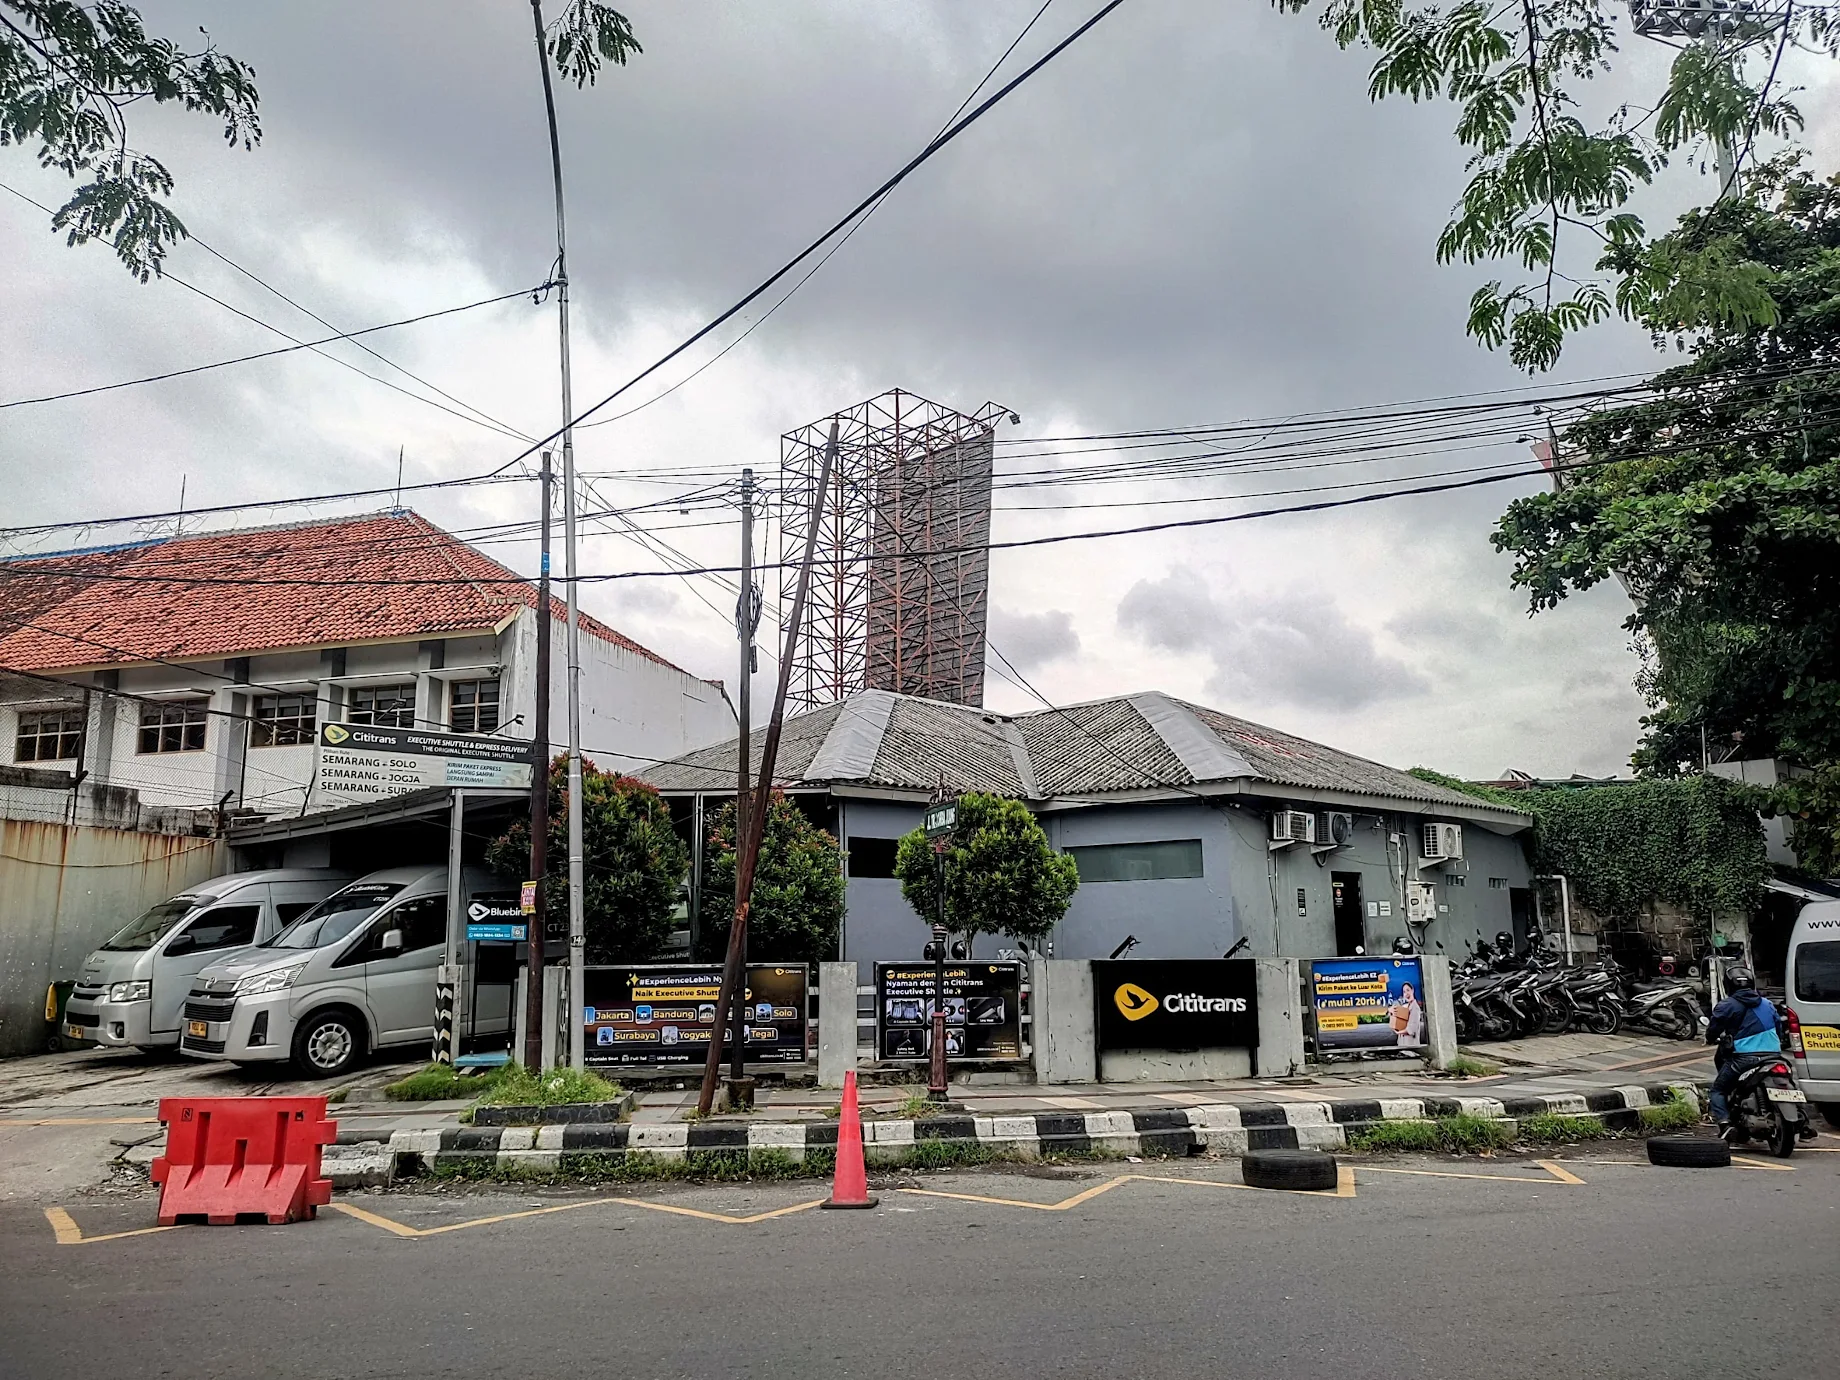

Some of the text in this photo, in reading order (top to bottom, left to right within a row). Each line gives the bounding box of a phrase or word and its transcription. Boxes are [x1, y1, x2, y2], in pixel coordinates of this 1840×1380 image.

[352, 731, 397, 744] Cititrans
[407, 736, 529, 754] EXECUTIVE SHUTTLE & EXPRESS DELIVERY
[434, 746, 461, 755] ORIGINAL
[461, 748, 491, 757] EXECUTIVE
[491, 751, 515, 760] SHUTTLE
[321, 754, 417, 769] SEMARANG SOLO
[446, 769, 495, 778] LANGSUNG SAMPAI
[479, 764, 502, 772] EXPRESS
[321, 768, 380, 781] SEMARANG
[388, 773, 421, 784] JOGJA
[320, 781, 379, 794] SEMARANG
[639, 975, 710, 986] #ExperienceLebih
[896, 970, 967, 980] #ExperienLebih
[1321, 973, 1369, 983] #ExperienceLebih
[886, 980, 918, 988] Nyaman
[919, 979, 949, 988] denn
[635, 989, 653, 998] Naik
[655, 988, 694, 997] Executive
[886, 987, 954, 996] Executive Shtle
[1162, 992, 1247, 1013] Cititrans
[596, 1009, 793, 1020] Jakarta Bandung Solo
[614, 1030, 656, 1041] Surabaya
[751, 1029, 775, 1039] Tegal
[1807, 1040, 1840, 1049] Shuttle
